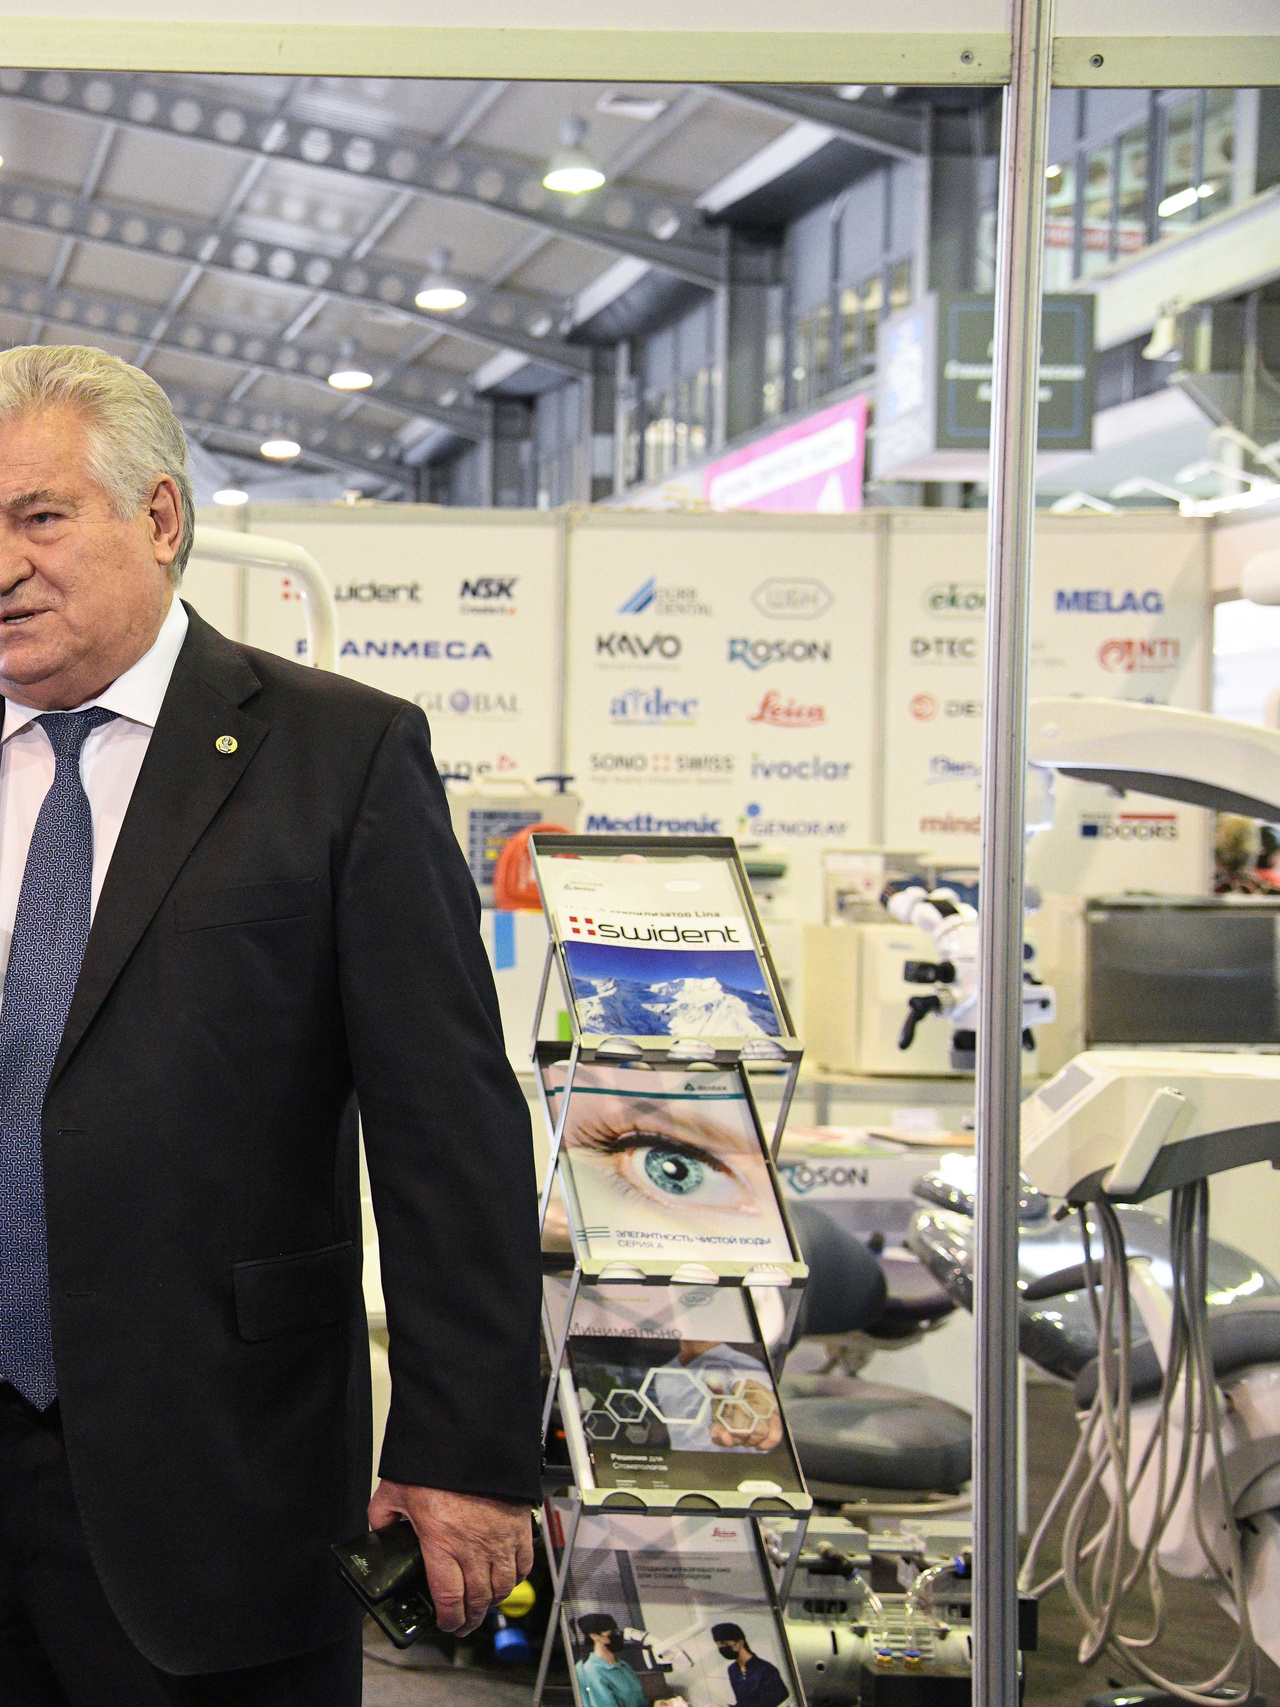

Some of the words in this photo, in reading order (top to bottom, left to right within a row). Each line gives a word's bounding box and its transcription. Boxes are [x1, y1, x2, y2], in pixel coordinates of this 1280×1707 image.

[460, 577, 517, 599] NSK
[1055, 590, 1164, 613] MELAG
[296, 639, 492, 659] PANMECA
[728, 638, 832, 671] ROSON
[751, 753, 851, 779] ivoclar
[586, 814, 720, 835] Medtronic
[598, 923, 741, 944] Swident
[616, 1230, 694, 1243] ЭЛЕГАНТНОСТЬ
[695, 1236, 737, 1244] ЧИСТОЙ
[740, 1237, 772, 1246] ВОДЫ
[618, 1239, 654, 1249] СЕРИЯ
